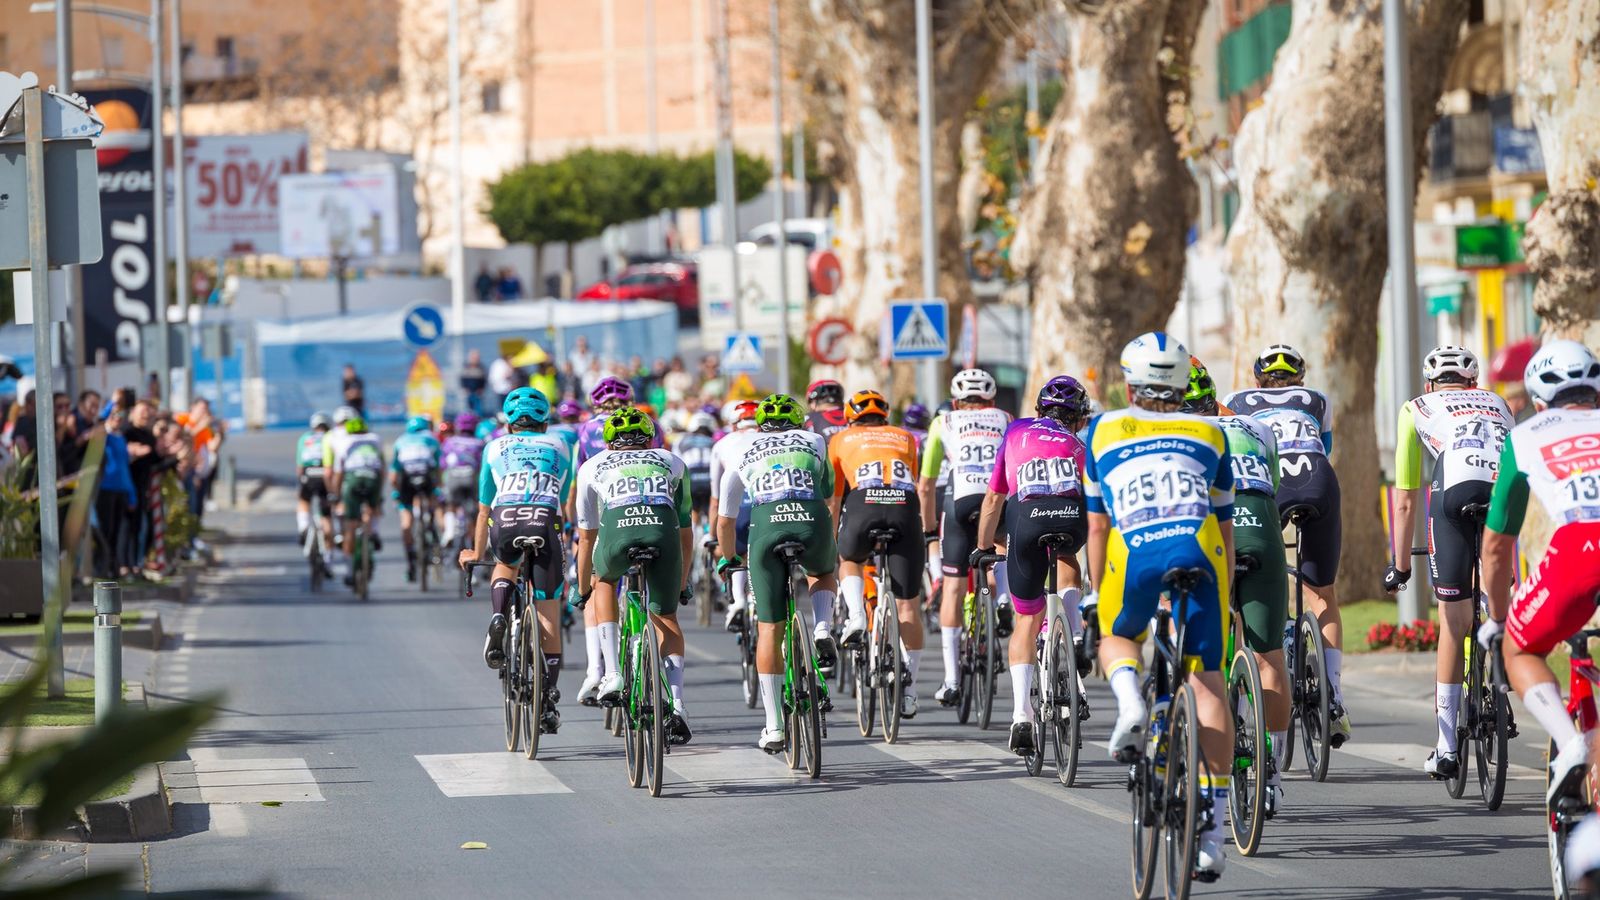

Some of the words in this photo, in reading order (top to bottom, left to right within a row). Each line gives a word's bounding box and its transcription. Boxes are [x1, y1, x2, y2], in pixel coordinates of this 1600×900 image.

[198, 161, 279, 207] 50%
[111, 213, 151, 358] PSOL
[1270, 421, 1284, 440] 6
[960, 444, 995, 462] 313
[1134, 440, 1196, 453] baloise
[1552, 436, 1600, 457] PO
[1465, 455, 1500, 471] Circ
[965, 474, 989, 485] Circ
[1017, 459, 1047, 485] 102
[500, 471, 528, 493] 175
[532, 470, 560, 495] 175
[608, 476, 638, 498] 126
[1118, 473, 1157, 511] 155
[1161, 470, 1208, 500] 155
[1565, 474, 1600, 501] 13
[866, 489, 906, 497] EUSKADI
[500, 506, 549, 522] CSF
[624, 505, 655, 517] CAJA
[775, 502, 805, 513] CAJA
[1029, 505, 1079, 518] Burpellet
[1232, 506, 1252, 517] JA
[616, 516, 664, 529] RURAL
[770, 512, 815, 523] RURAL
[1232, 516, 1263, 528] RAL
[1143, 525, 1195, 543] baloise
